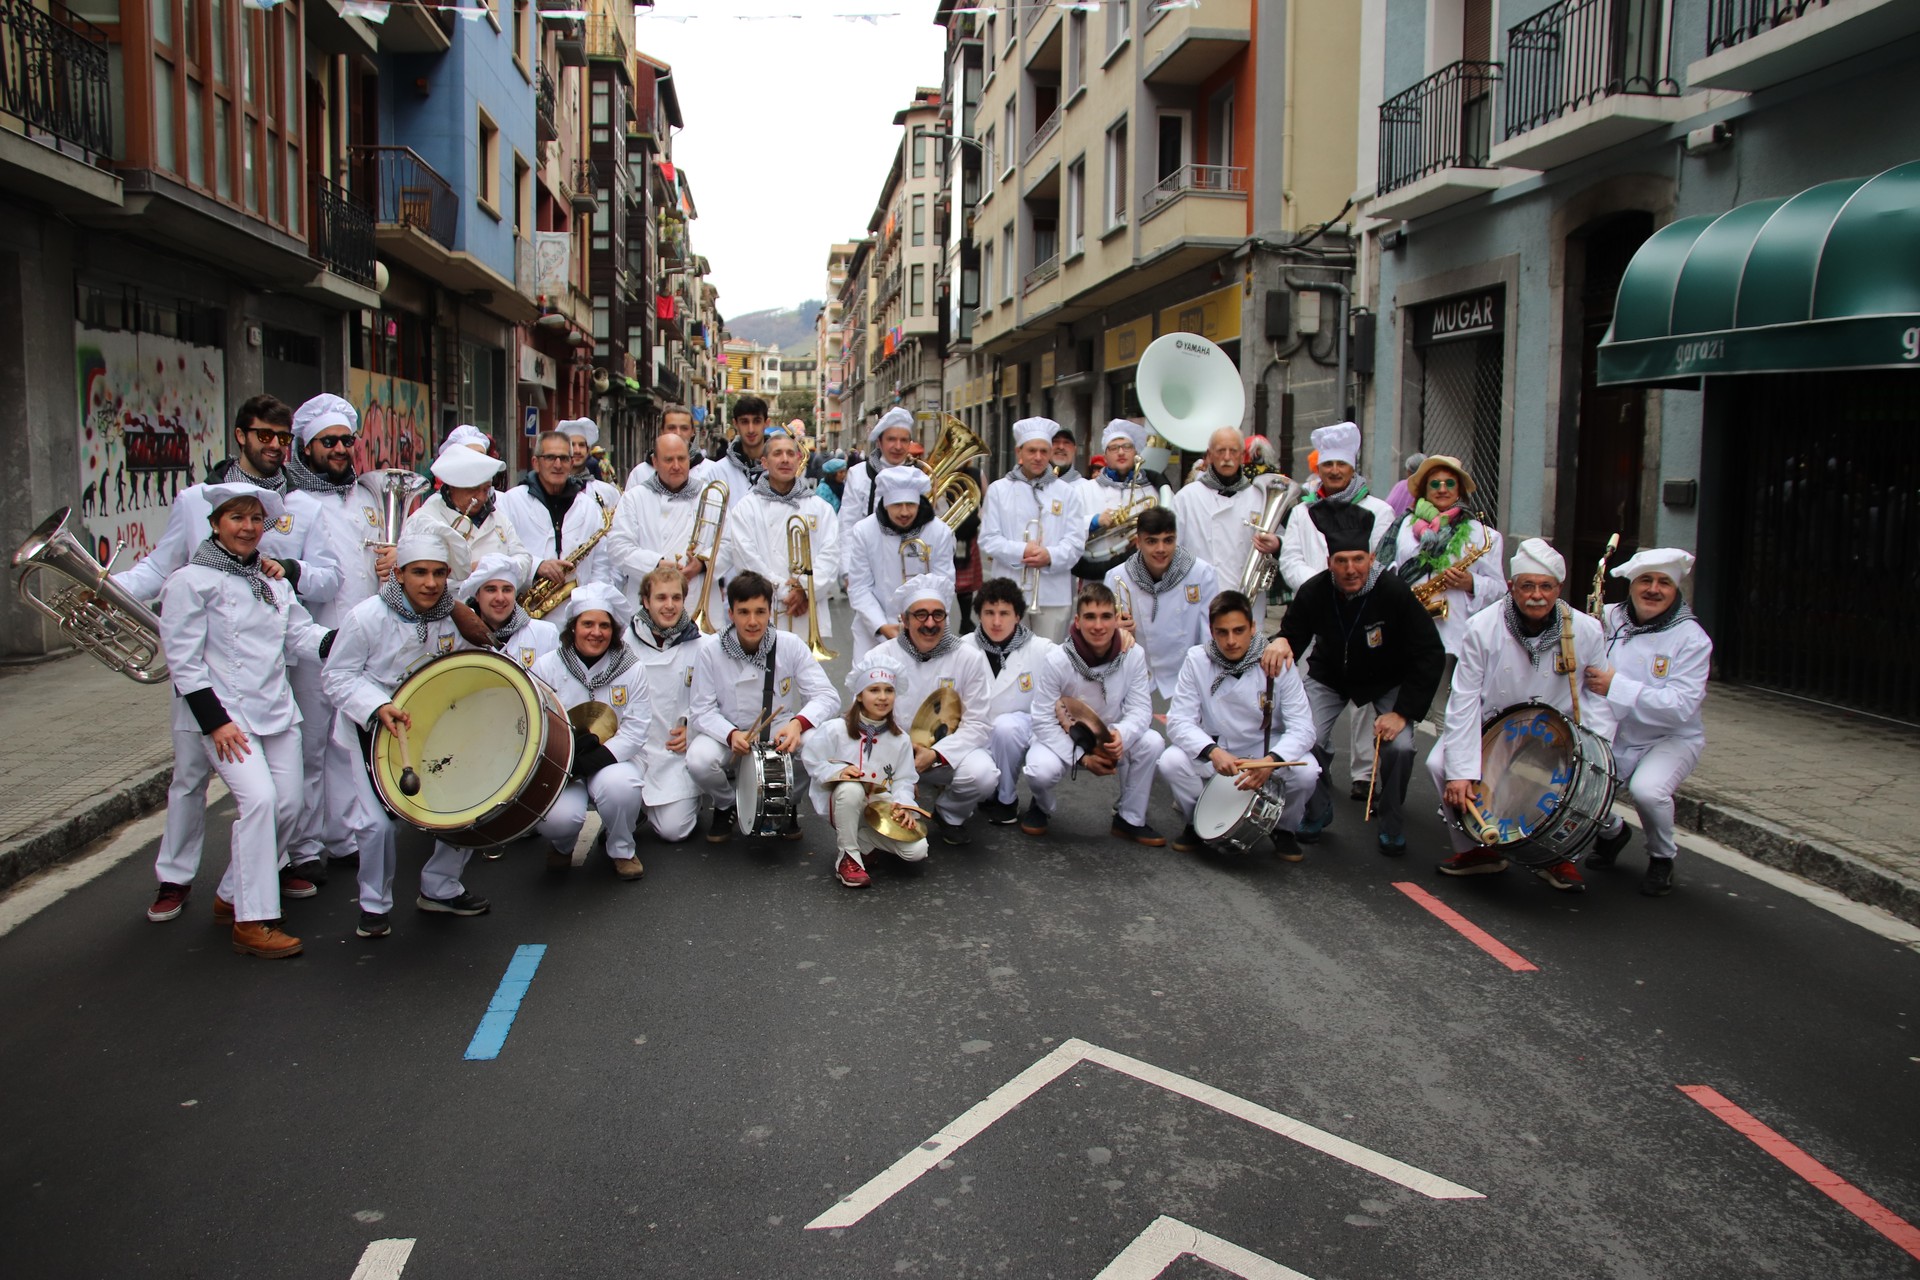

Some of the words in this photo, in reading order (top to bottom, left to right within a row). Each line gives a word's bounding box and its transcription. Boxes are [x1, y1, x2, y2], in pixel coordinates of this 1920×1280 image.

[1431, 296, 1493, 333] MUGAR
[1184, 341, 1211, 356] YAMAHA
[1675, 339, 1725, 371] garazi
[117, 521, 146, 549] AUPA
